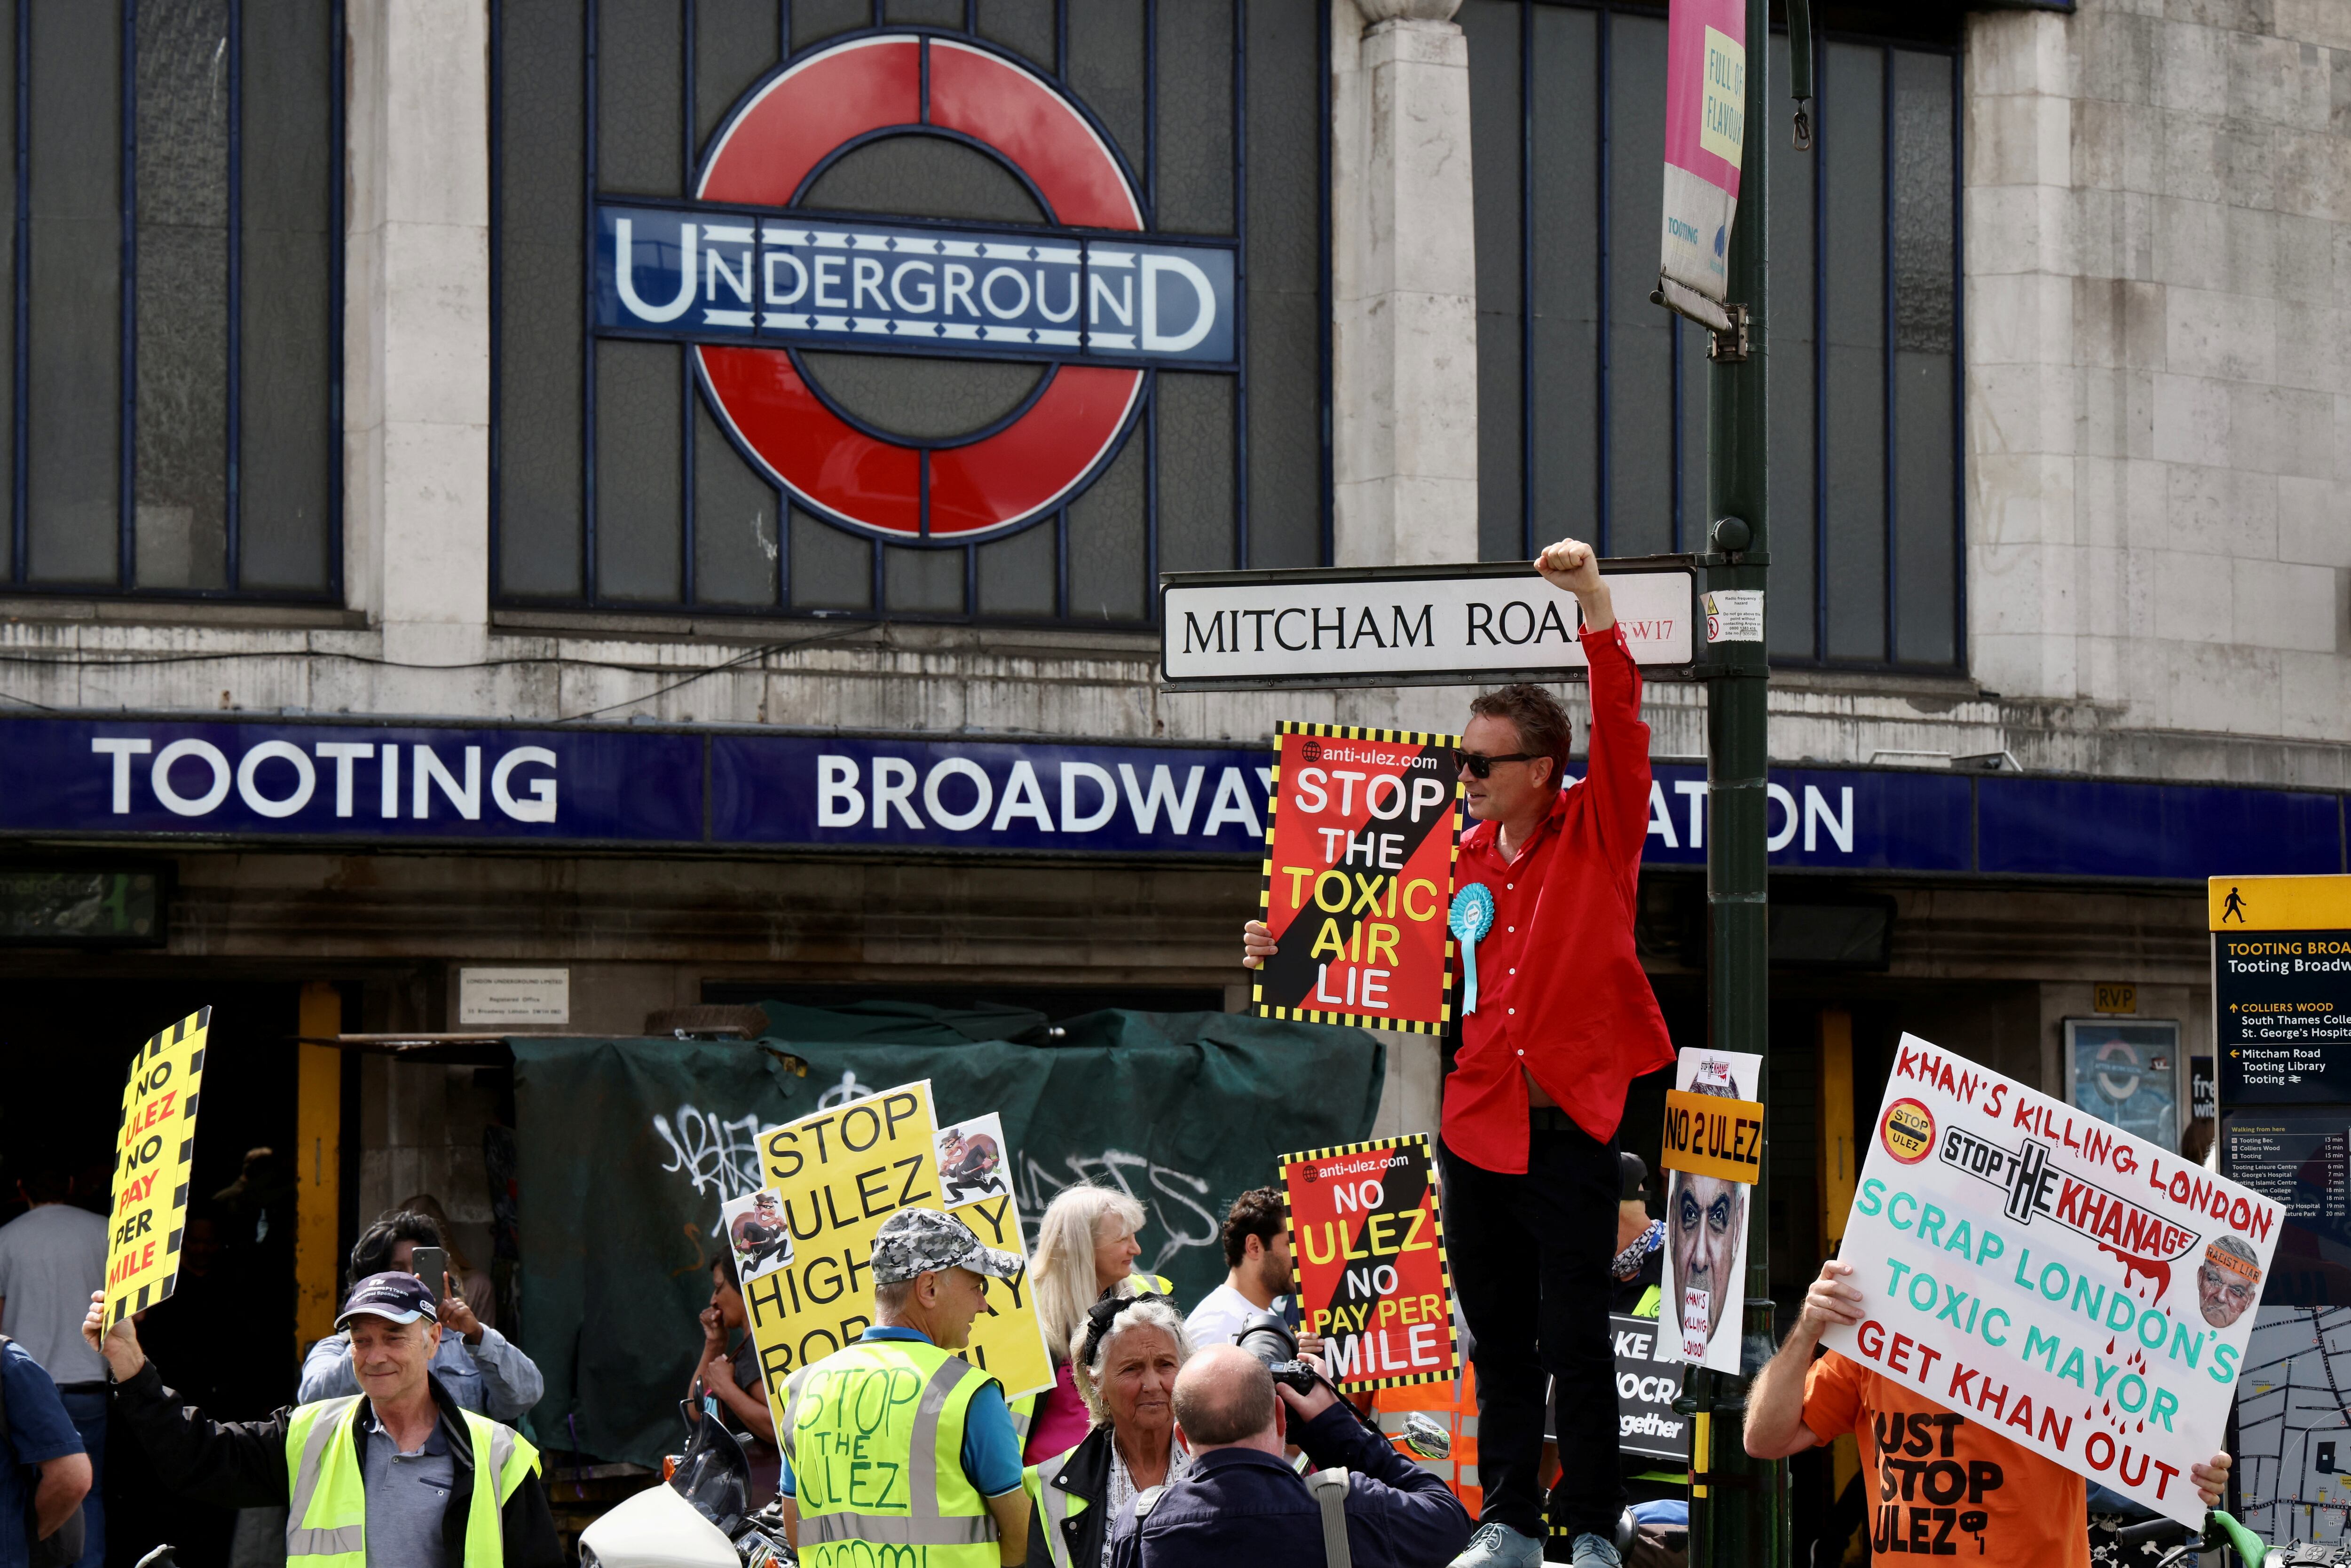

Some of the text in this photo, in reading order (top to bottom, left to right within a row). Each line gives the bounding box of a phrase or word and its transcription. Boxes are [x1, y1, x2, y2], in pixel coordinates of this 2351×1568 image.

[1710, 48, 1743, 98] FULL OF
[1708, 95, 1743, 147] FLAVOUR
[1668, 217, 1698, 244] TOOTING
[615, 218, 1216, 352] UNDERGROUND
[1183, 605, 1434, 654] MITCHAM
[1466, 600, 1581, 646] ROA
[1323, 747, 1437, 770] anti-ulez.com
[92, 738, 557, 824] TOOTING
[818, 755, 1270, 837] BROADWA
[1295, 767, 1444, 823] STOP
[1318, 827, 1404, 869] THE
[1282, 866, 1437, 922] TOXIC
[1310, 917, 1400, 967] AIR
[2228, 943, 2302, 955] TOOTING
[1317, 963, 1390, 1009] LIE
[2228, 960, 2289, 975] Tooting
[2099, 989, 2133, 1007] RVP
[2241, 1003, 2333, 1012] COLLIERS WOOD
[2242, 1016, 2274, 1025] South
[2277, 1016, 2320, 1024] Thames
[2242, 1029, 2256, 1038] St.
[2260, 1028, 2308, 1039] George's
[2243, 1049, 2320, 1058] Mitcham Road
[135, 1061, 172, 1106] NO
[2243, 1062, 2326, 1072] Tooting Library
[2243, 1075, 2284, 1085] Tooting
[125, 1089, 178, 1147] ULEZ
[769, 1093, 918, 1178] STOP
[1665, 1105, 1761, 1165] NO 2 ULEZ
[1895, 1110, 1928, 1130] STOP
[125, 1135, 162, 1180] NO
[1893, 1133, 1918, 1151] ULEZ
[1896, 1046, 2275, 1244] KHAN'S KILLING LONDON
[1320, 1154, 1408, 1178] anti-ulez.com
[119, 1167, 160, 1218] PAY
[785, 1154, 932, 1241] ULEZ
[1333, 1180, 1384, 1214] NO
[1944, 1131, 2193, 1257] STOP THE KHANAGE
[115, 1208, 153, 1255] PER
[1303, 1208, 1433, 1265] ULEZ
[107, 1240, 156, 1296] MILE
[1347, 1265, 1398, 1300] NO
[1856, 1178, 2240, 1384] SCRAP LONDON'S
[2207, 1247, 2259, 1281] RACIST LIAR
[393, 1288, 409, 1297] Team
[1313, 1294, 1442, 1336] PAY PER
[1686, 1291, 1705, 1310] KHAN'S
[1684, 1318, 1707, 1333] KILLING
[1886, 1257, 2179, 1433] TOXIC MAYOR
[1324, 1323, 1440, 1379] MILE
[1683, 1339, 1705, 1359] LONDON
[797, 1367, 921, 1437] STOP
[1857, 1320, 2180, 1500] GET KHAN OUT
[814, 1432, 870, 1459] THE
[799, 1456, 907, 1509] ULEZ
[1879, 1455, 2004, 1505] STOP
[1873, 1505, 1956, 1555] ULEZ
